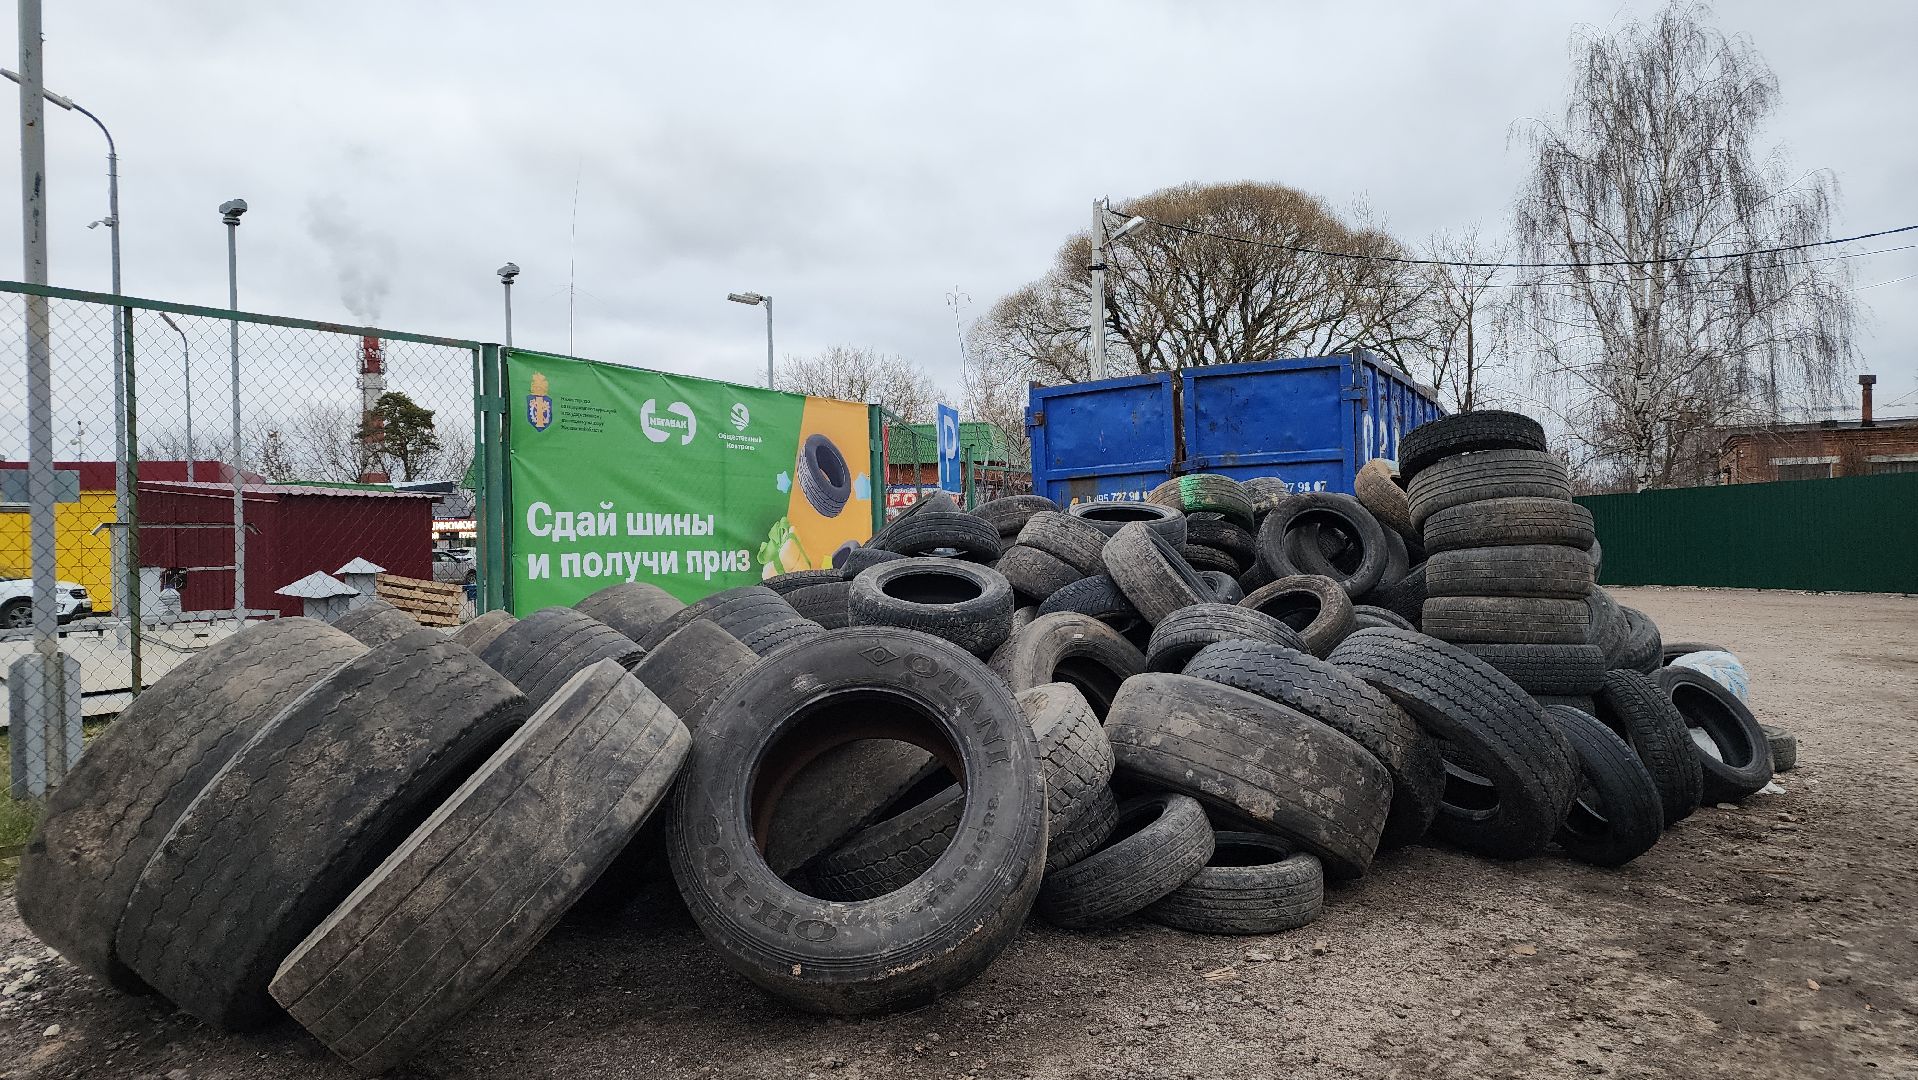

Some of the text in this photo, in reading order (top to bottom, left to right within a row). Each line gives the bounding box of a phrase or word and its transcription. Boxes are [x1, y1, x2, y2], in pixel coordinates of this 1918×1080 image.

[943, 414, 957, 483] P
[526, 500, 714, 543] Сдай шины
[527, 549, 751, 584] и получи приз
[904, 652, 1010, 768] OTANI
